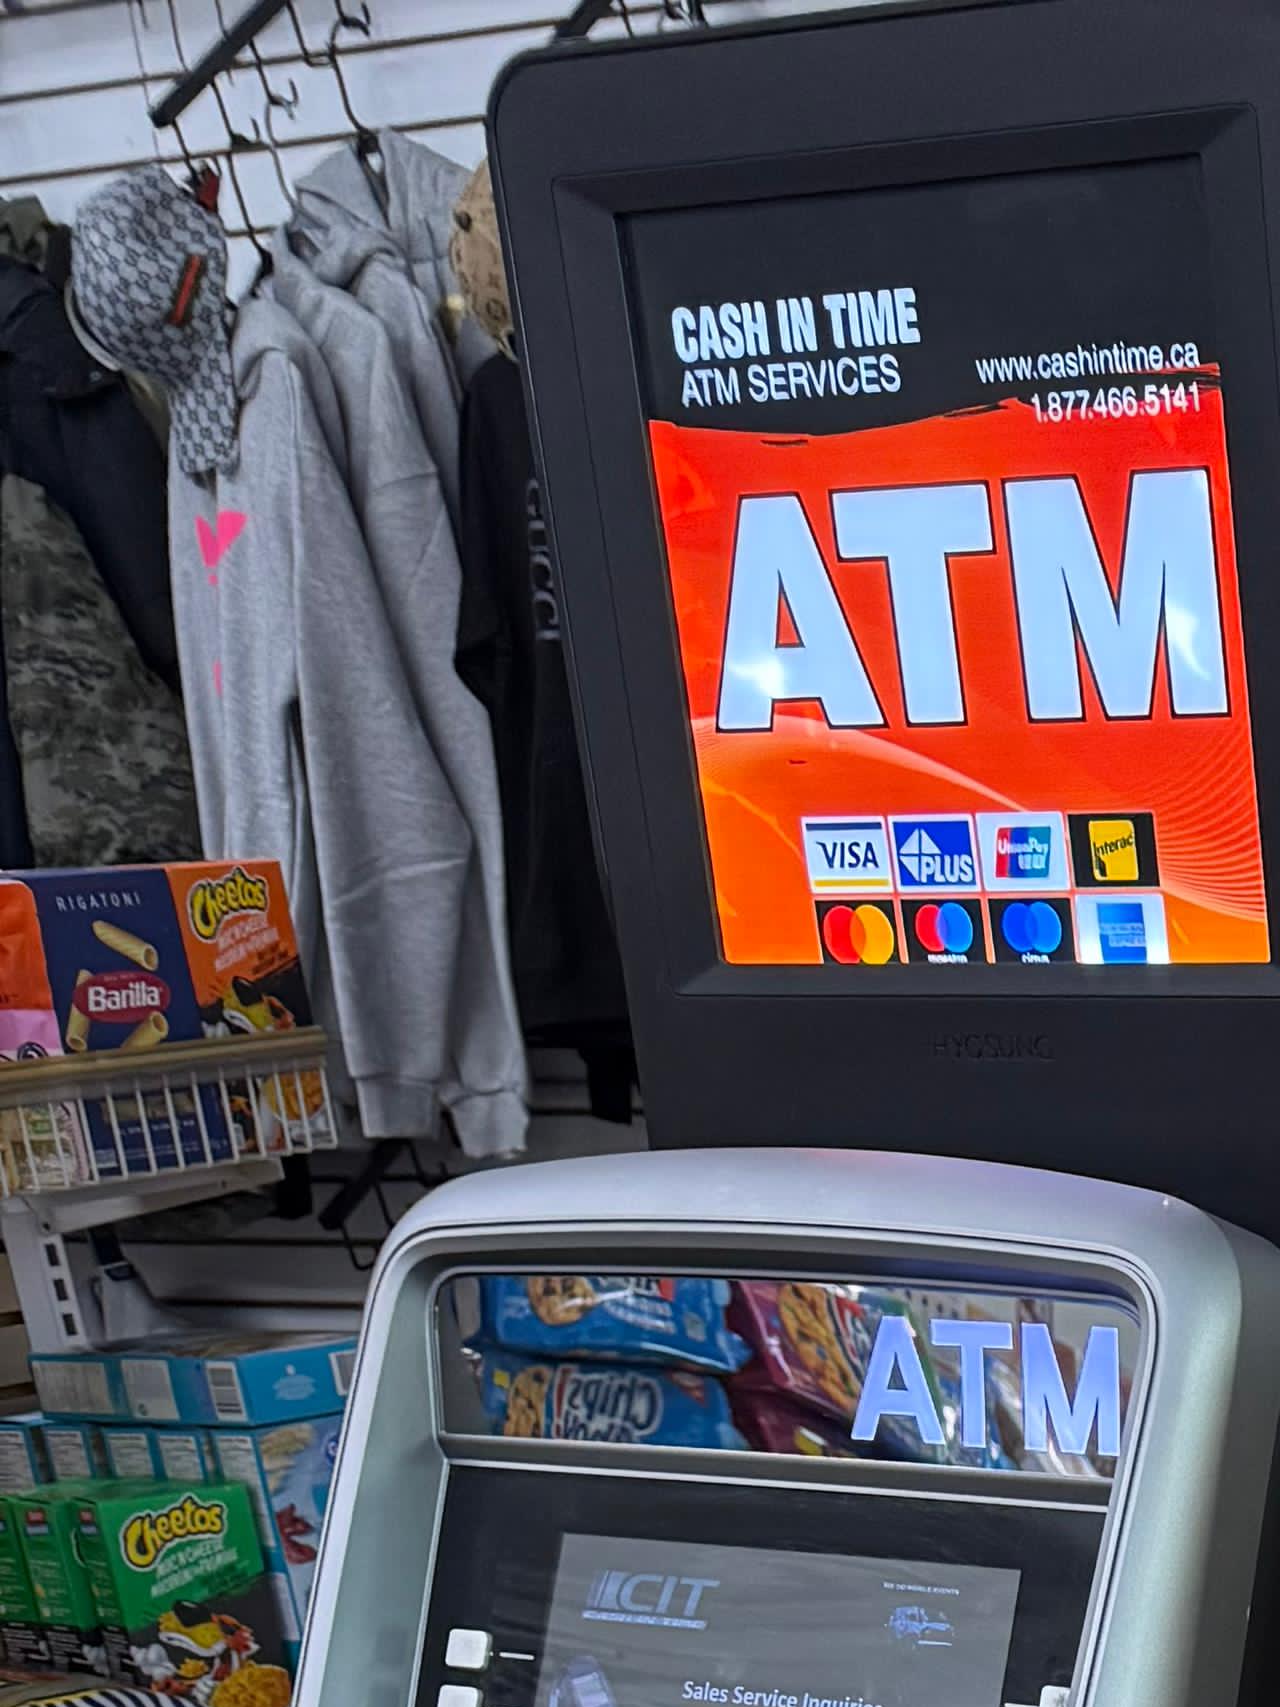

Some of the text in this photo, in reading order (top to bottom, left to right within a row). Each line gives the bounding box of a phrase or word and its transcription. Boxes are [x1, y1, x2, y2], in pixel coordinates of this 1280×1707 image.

[672, 288, 920, 364] CASH IN TIME
[681, 355, 901, 408] ATM SERVICES
[976, 341, 1200, 385] www.cashintime.ca
[1031, 383, 1200, 424] 1.877.466.5141
[716, 466, 1230, 734] ATM
[816, 841, 879, 869] VISA
[920, 853, 973, 883] PLUS
[56, 892, 140, 912] RIGATONI
[190, 873, 267, 940] Cheetos
[88, 980, 163, 1012] Barilla
[850, 1315, 1122, 1456] ATM
[123, 1499, 224, 1568] Cheetos
[682, 1681, 728, 1704] Sales
